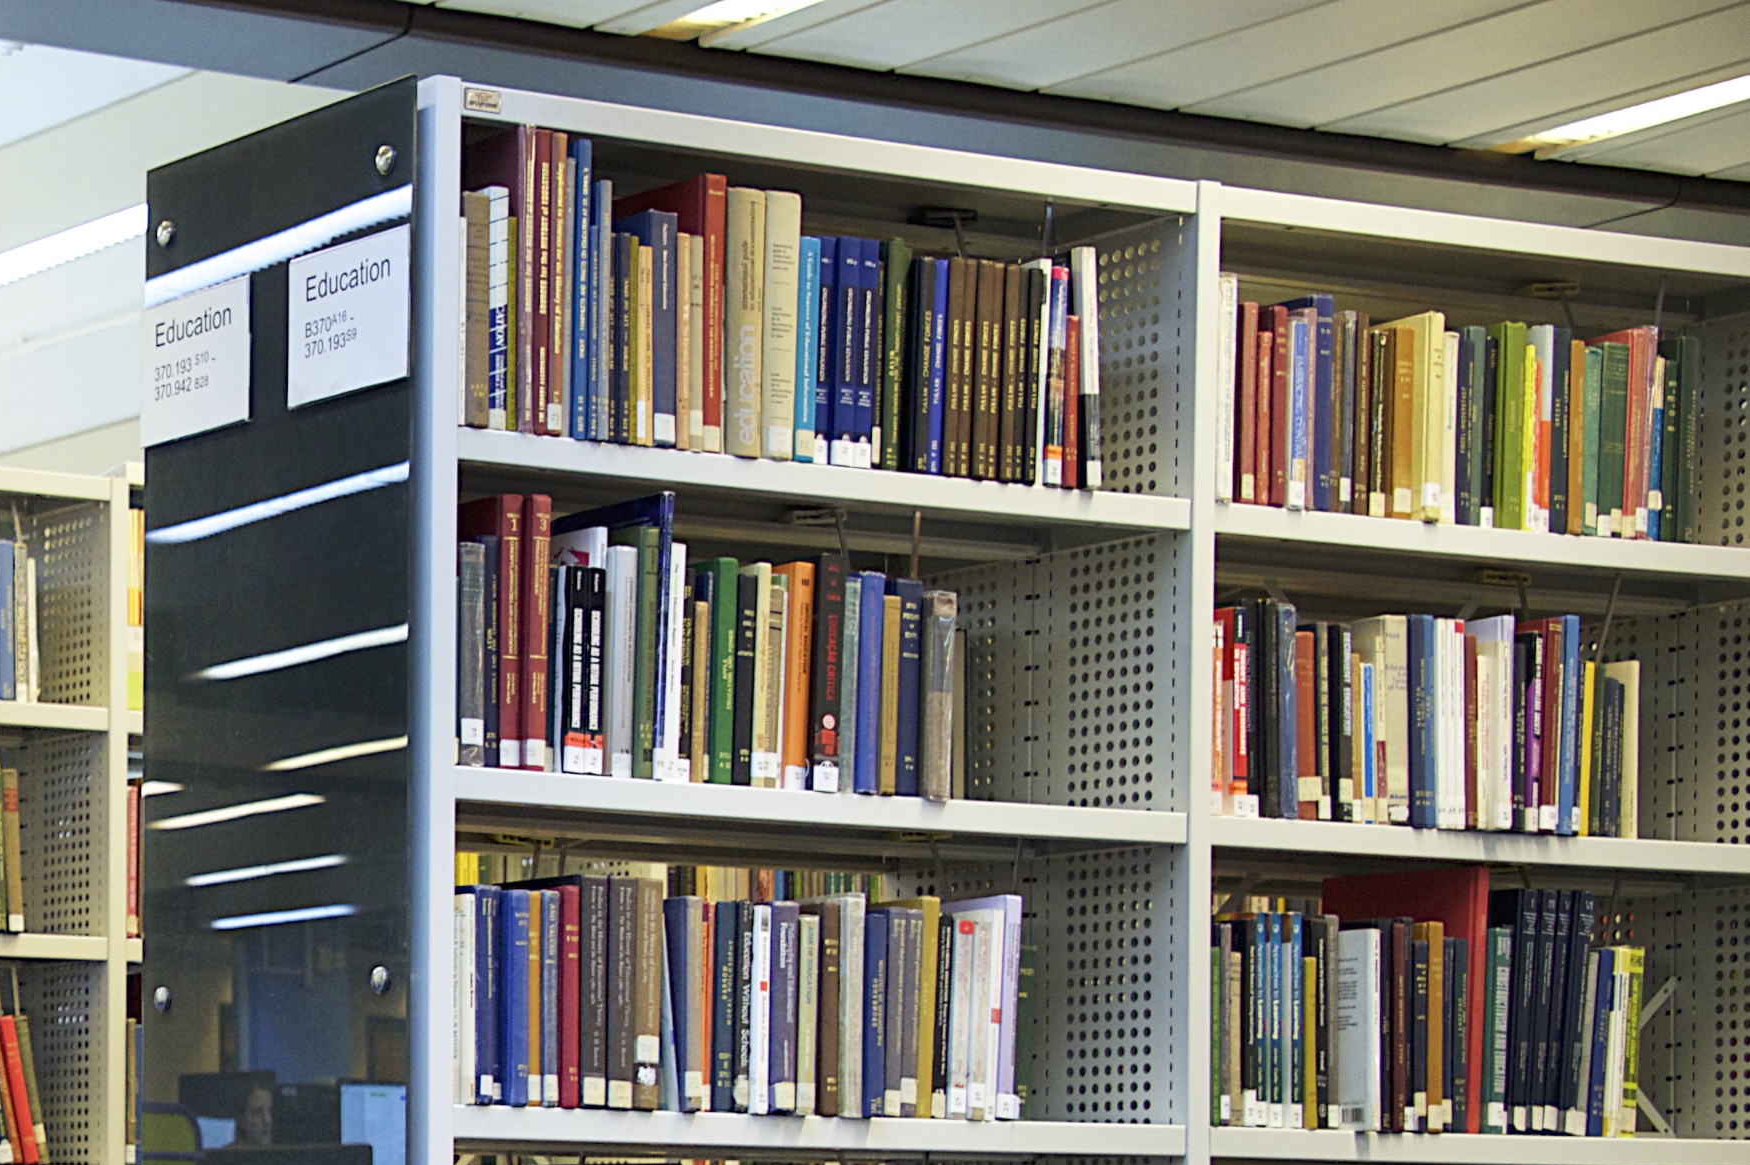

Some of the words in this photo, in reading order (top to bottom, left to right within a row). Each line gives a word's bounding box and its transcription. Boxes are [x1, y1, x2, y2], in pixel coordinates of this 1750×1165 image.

[541, 162, 550, 205] EDUCATION
[555, 162, 564, 206] Supplement
[541, 206, 549, 215] of
[555, 209, 563, 217] to
[540, 217, 549, 249] HISTORY
[555, 219, 563, 246] Sources
[555, 248, 563, 259] for
[742, 240, 750, 261] guide
[305, 258, 391, 302] Education
[540, 266, 548, 278] for
[555, 261, 563, 274] the
[539, 280, 549, 314] SOURCES
[554, 277, 562, 305] History
[741, 263, 749, 310] international
[554, 306, 562, 314] of
[805, 321, 811, 329] of
[155, 306, 231, 348] Education
[553, 315, 561, 354] Education
[155, 355, 192, 383] 370.193
[195, 351, 209, 365] S10
[803, 330, 811, 376] Educational
[963, 349, 971, 375] CHANGE
[155, 377, 192, 401] 370.942
[195, 375, 209, 389] B28
[734, 325, 756, 445] education
[510, 518, 517, 532] 1
[539, 518, 547, 532] 3
[826, 614, 839, 663] EDUCAÇÃO
[1234, 649, 1239, 659] IN
[742, 931, 751, 979] Education
[786, 922, 795, 962] Philosophy
[807, 947, 813, 957] OF
[1271, 943, 1279, 988] Approaches
[741, 984, 750, 1024] Without
[1257, 990, 1263, 998] to
[1293, 991, 1299, 999] to
[1256, 999, 1264, 1039] Learning
[1271, 999, 1279, 1040] Learning
[740, 1029, 749, 1067] Schools
